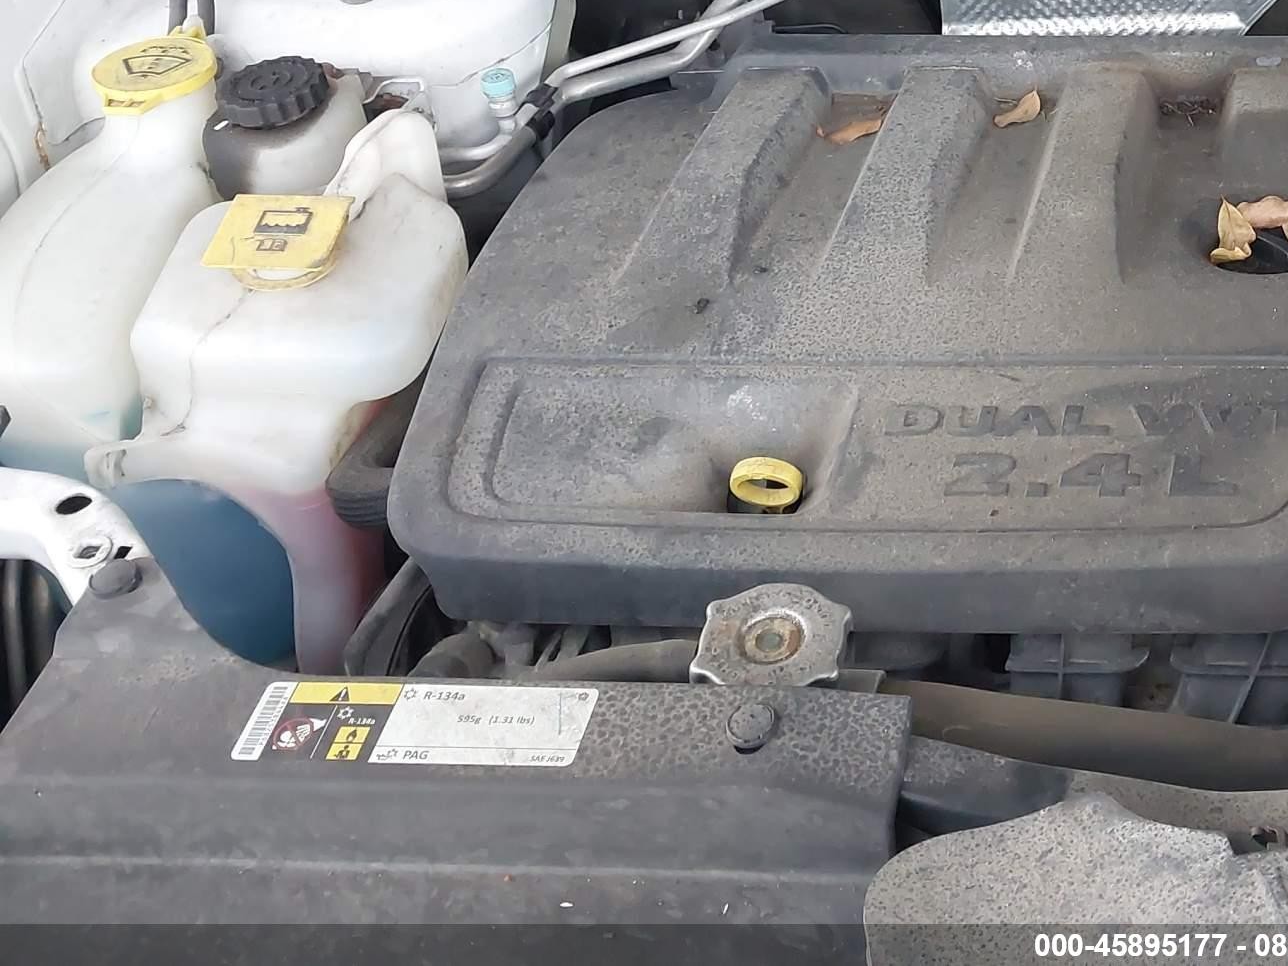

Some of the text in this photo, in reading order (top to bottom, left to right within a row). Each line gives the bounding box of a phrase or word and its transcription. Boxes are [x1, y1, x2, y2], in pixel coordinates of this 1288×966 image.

[884, 404, 1110, 435] DUAL
[944, 452, 1239, 498] 2.4L
[423, 690, 466, 702] R-134a
[348, 718, 376, 726] R-134a
[457, 715, 536, 726] 595g (1.31 lbs)
[403, 750, 428, 761] PAG
[548, 755, 565, 763] J639
